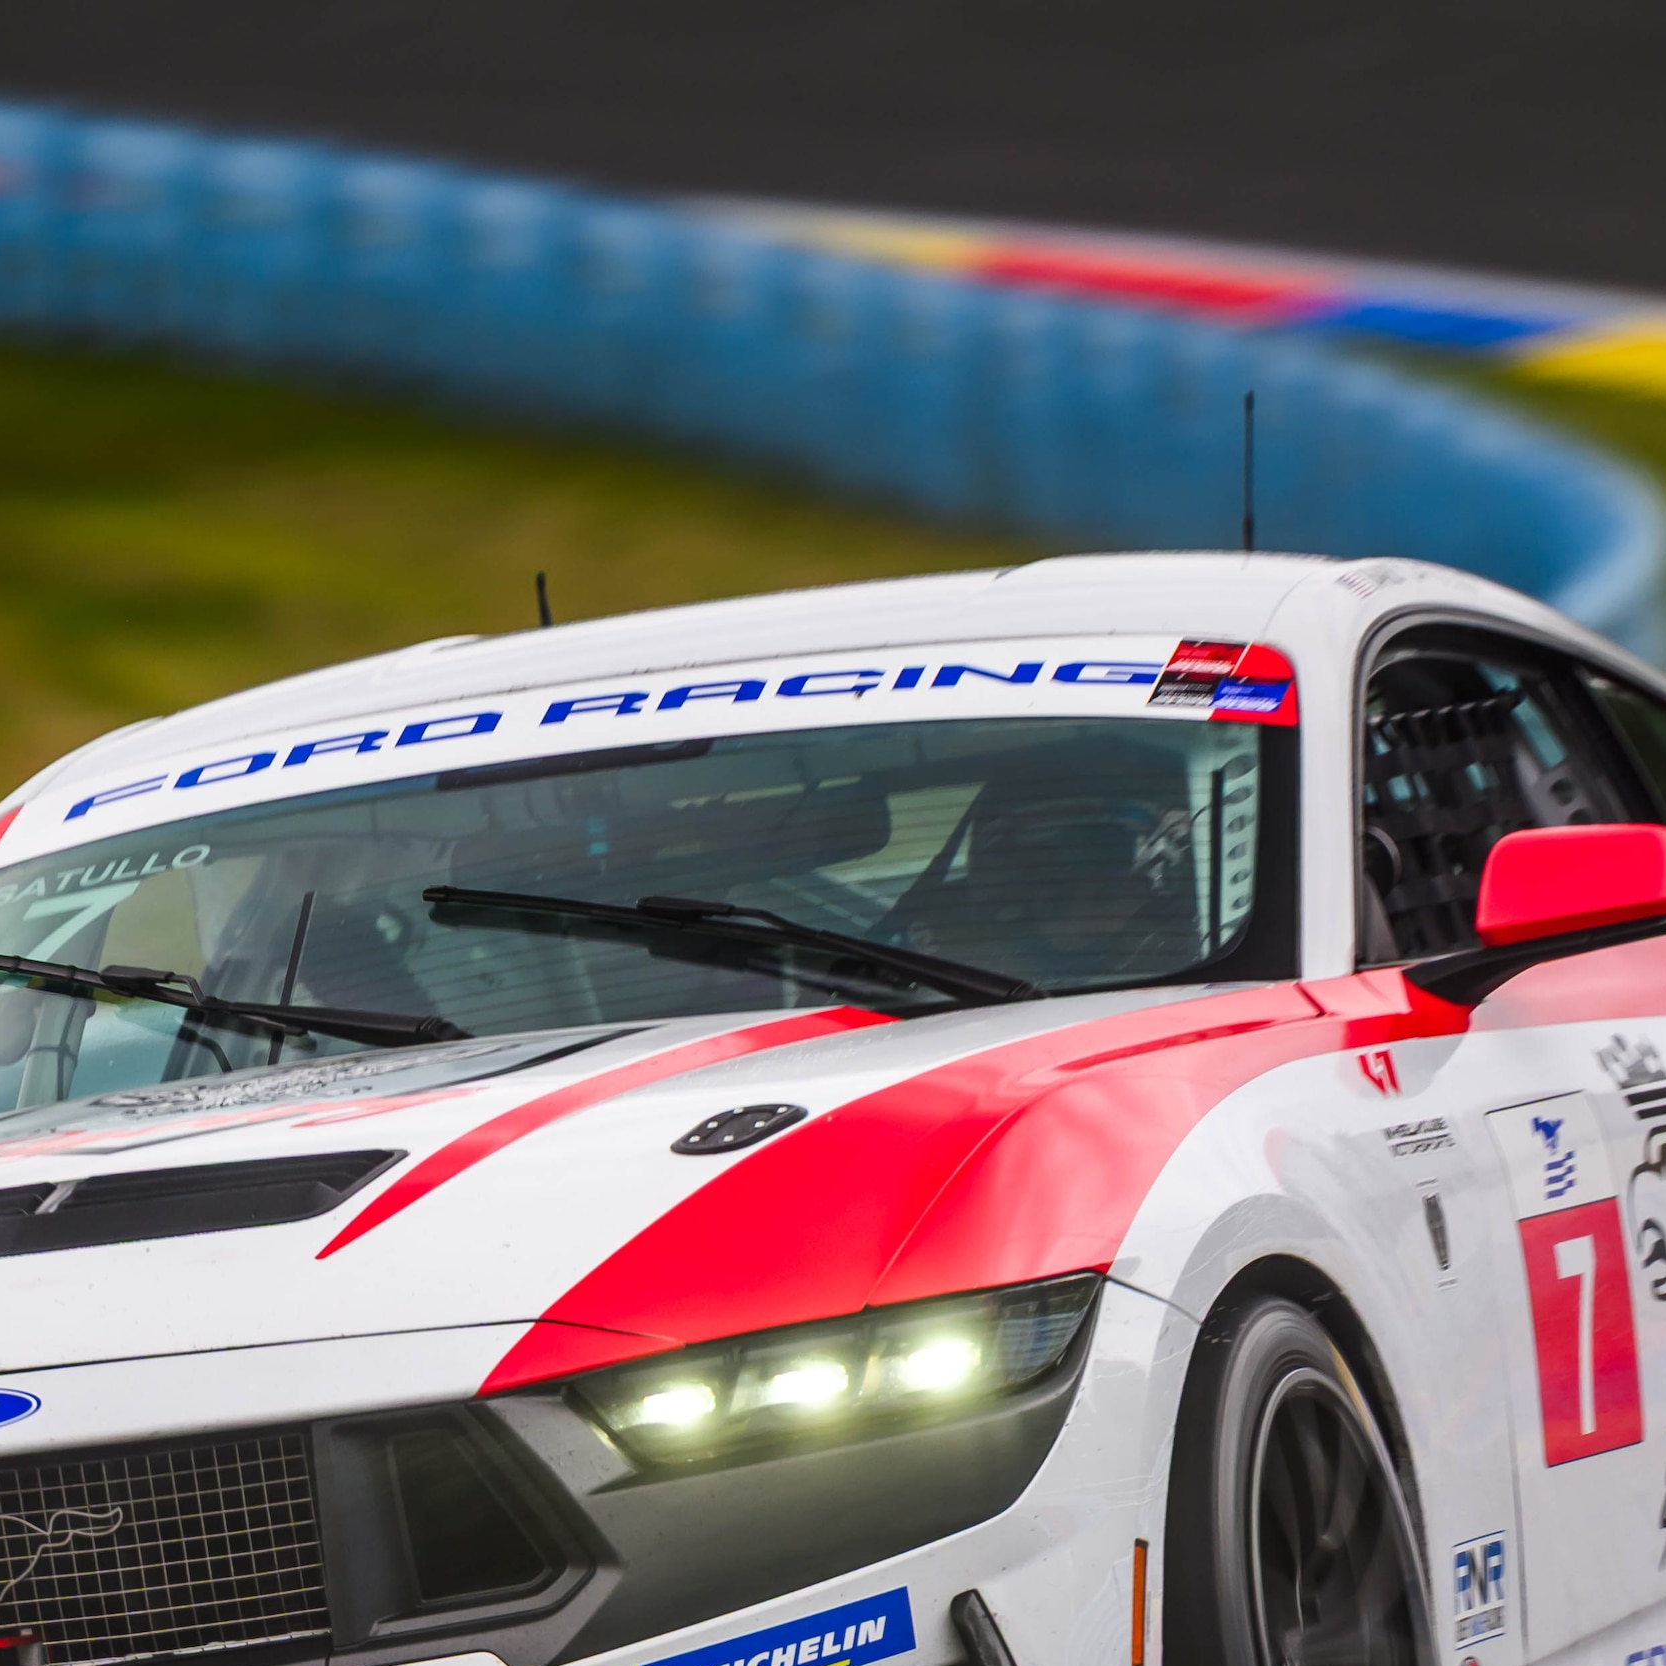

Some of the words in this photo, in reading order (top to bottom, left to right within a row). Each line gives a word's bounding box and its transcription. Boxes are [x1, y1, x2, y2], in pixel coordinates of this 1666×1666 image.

[63, 710, 504, 823] FORD
[538, 660, 1167, 726] RACING
[1552, 1233, 1597, 1436] 7
